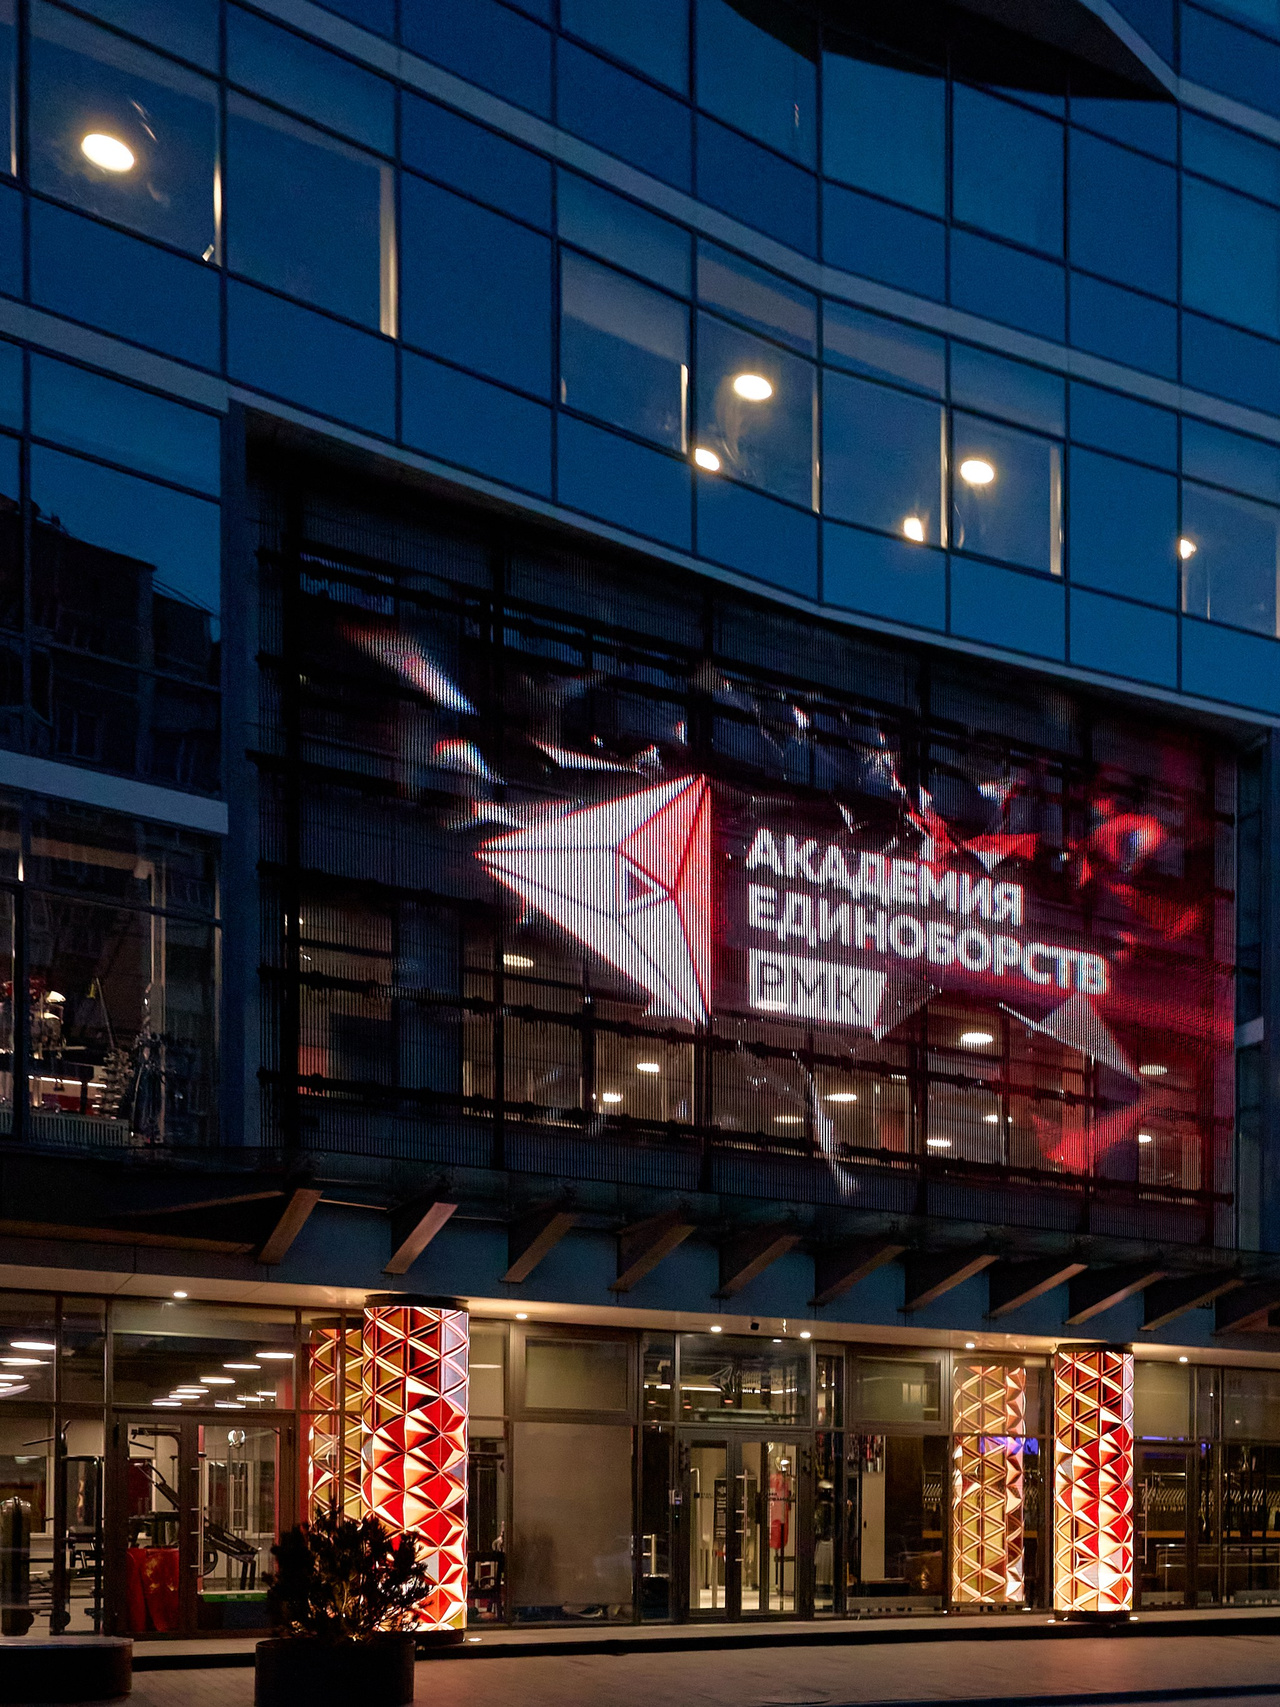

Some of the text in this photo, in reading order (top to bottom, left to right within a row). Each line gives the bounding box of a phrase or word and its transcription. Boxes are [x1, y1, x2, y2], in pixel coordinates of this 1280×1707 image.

[746, 828, 1024, 927] АКАДЕМИЯ
[748, 883, 1109, 995] ЕДИНОБОРСТВ
[757, 959, 863, 1016] РМК
